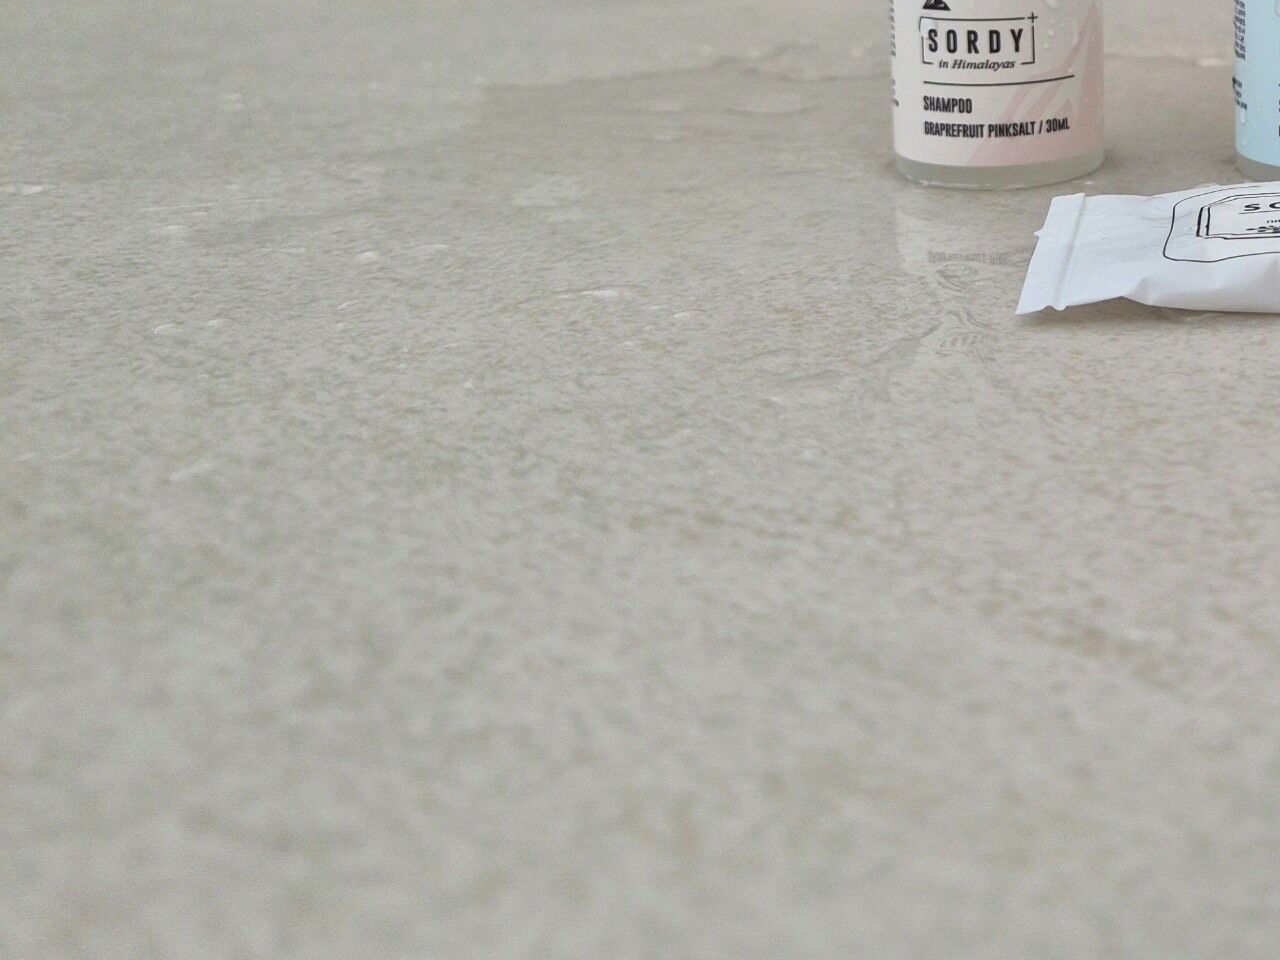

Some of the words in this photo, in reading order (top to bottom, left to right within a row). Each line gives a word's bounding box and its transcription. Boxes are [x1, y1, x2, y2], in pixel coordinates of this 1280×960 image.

[927, 28, 1024, 54] SORDY
[938, 59, 949, 69] in
[951, 59, 1016, 72] Himalayas
[923, 95, 973, 114] SHAMPOO
[924, 120, 985, 138] GRAPREFRUIT
[988, 120, 1036, 138] PINKSALT
[1046, 117, 1070, 134] 30ML
